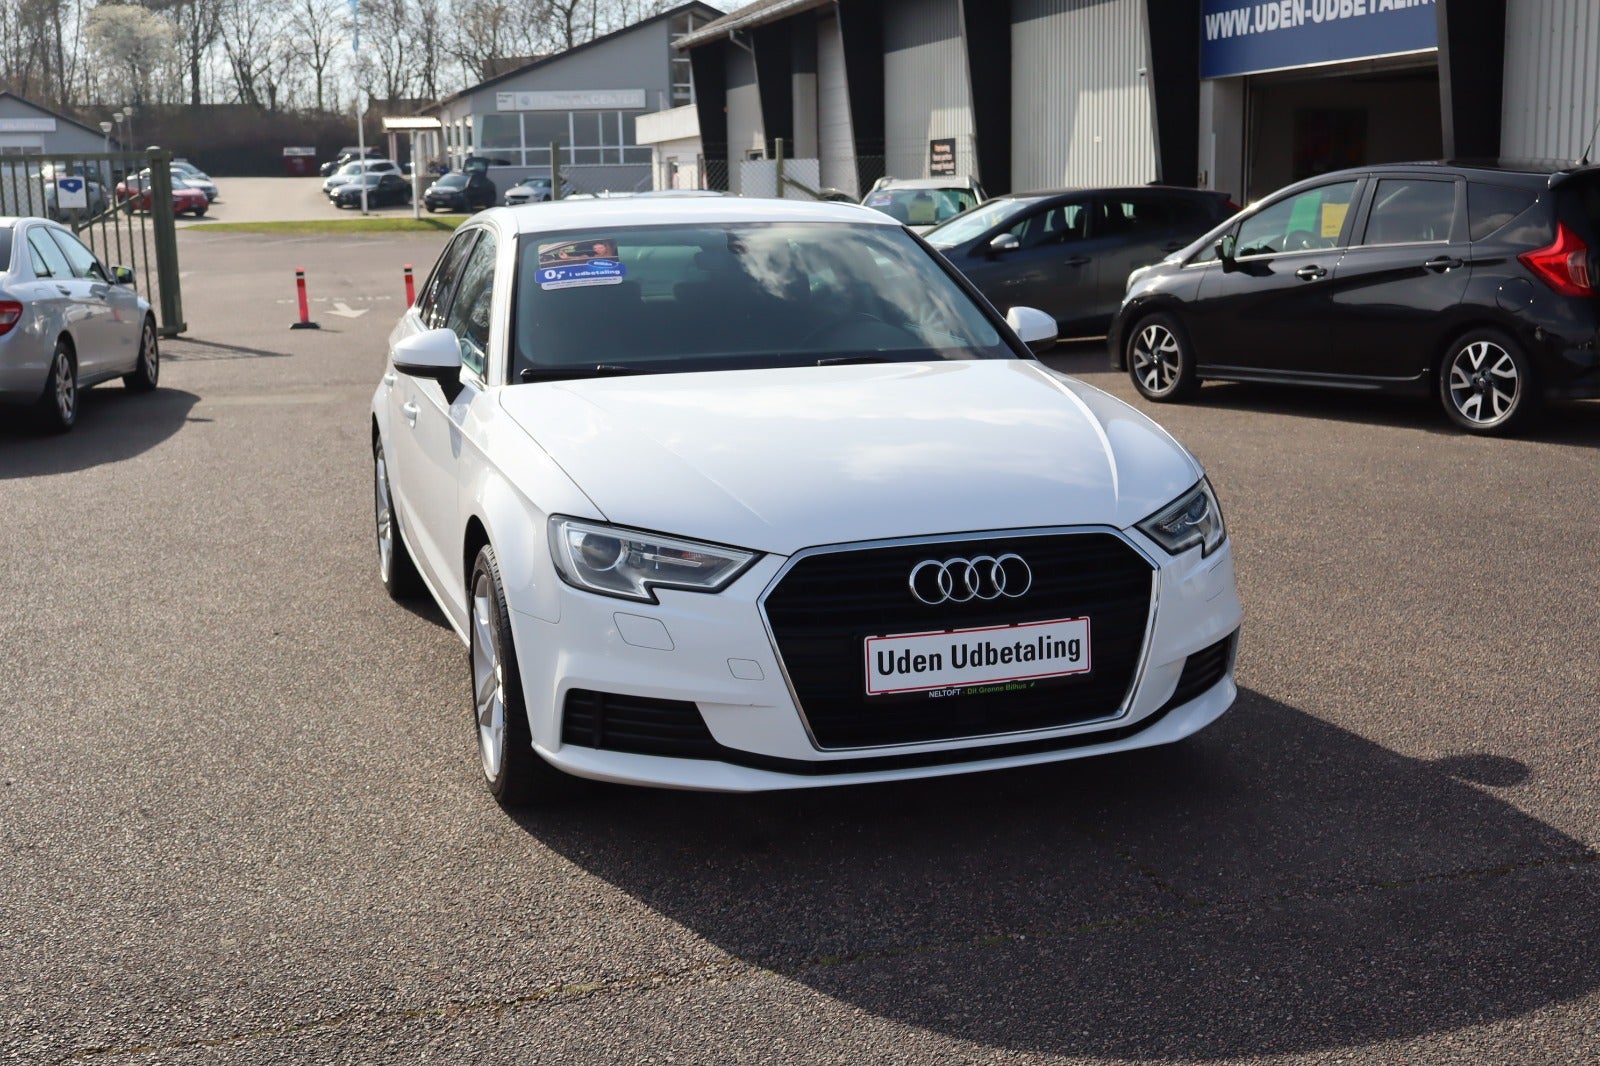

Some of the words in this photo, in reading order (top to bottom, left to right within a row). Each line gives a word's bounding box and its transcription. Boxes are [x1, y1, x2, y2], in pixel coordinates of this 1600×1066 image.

[1205, 0, 1436, 40] WWW.UDEN-UDBE
[575, 269, 620, 277] udbetaling
[877, 649, 942, 676] Uden
[951, 635, 1080, 669] Udbetaling
[928, 688, 961, 698] NELTOFT
[967, 687, 978, 695] Dit
